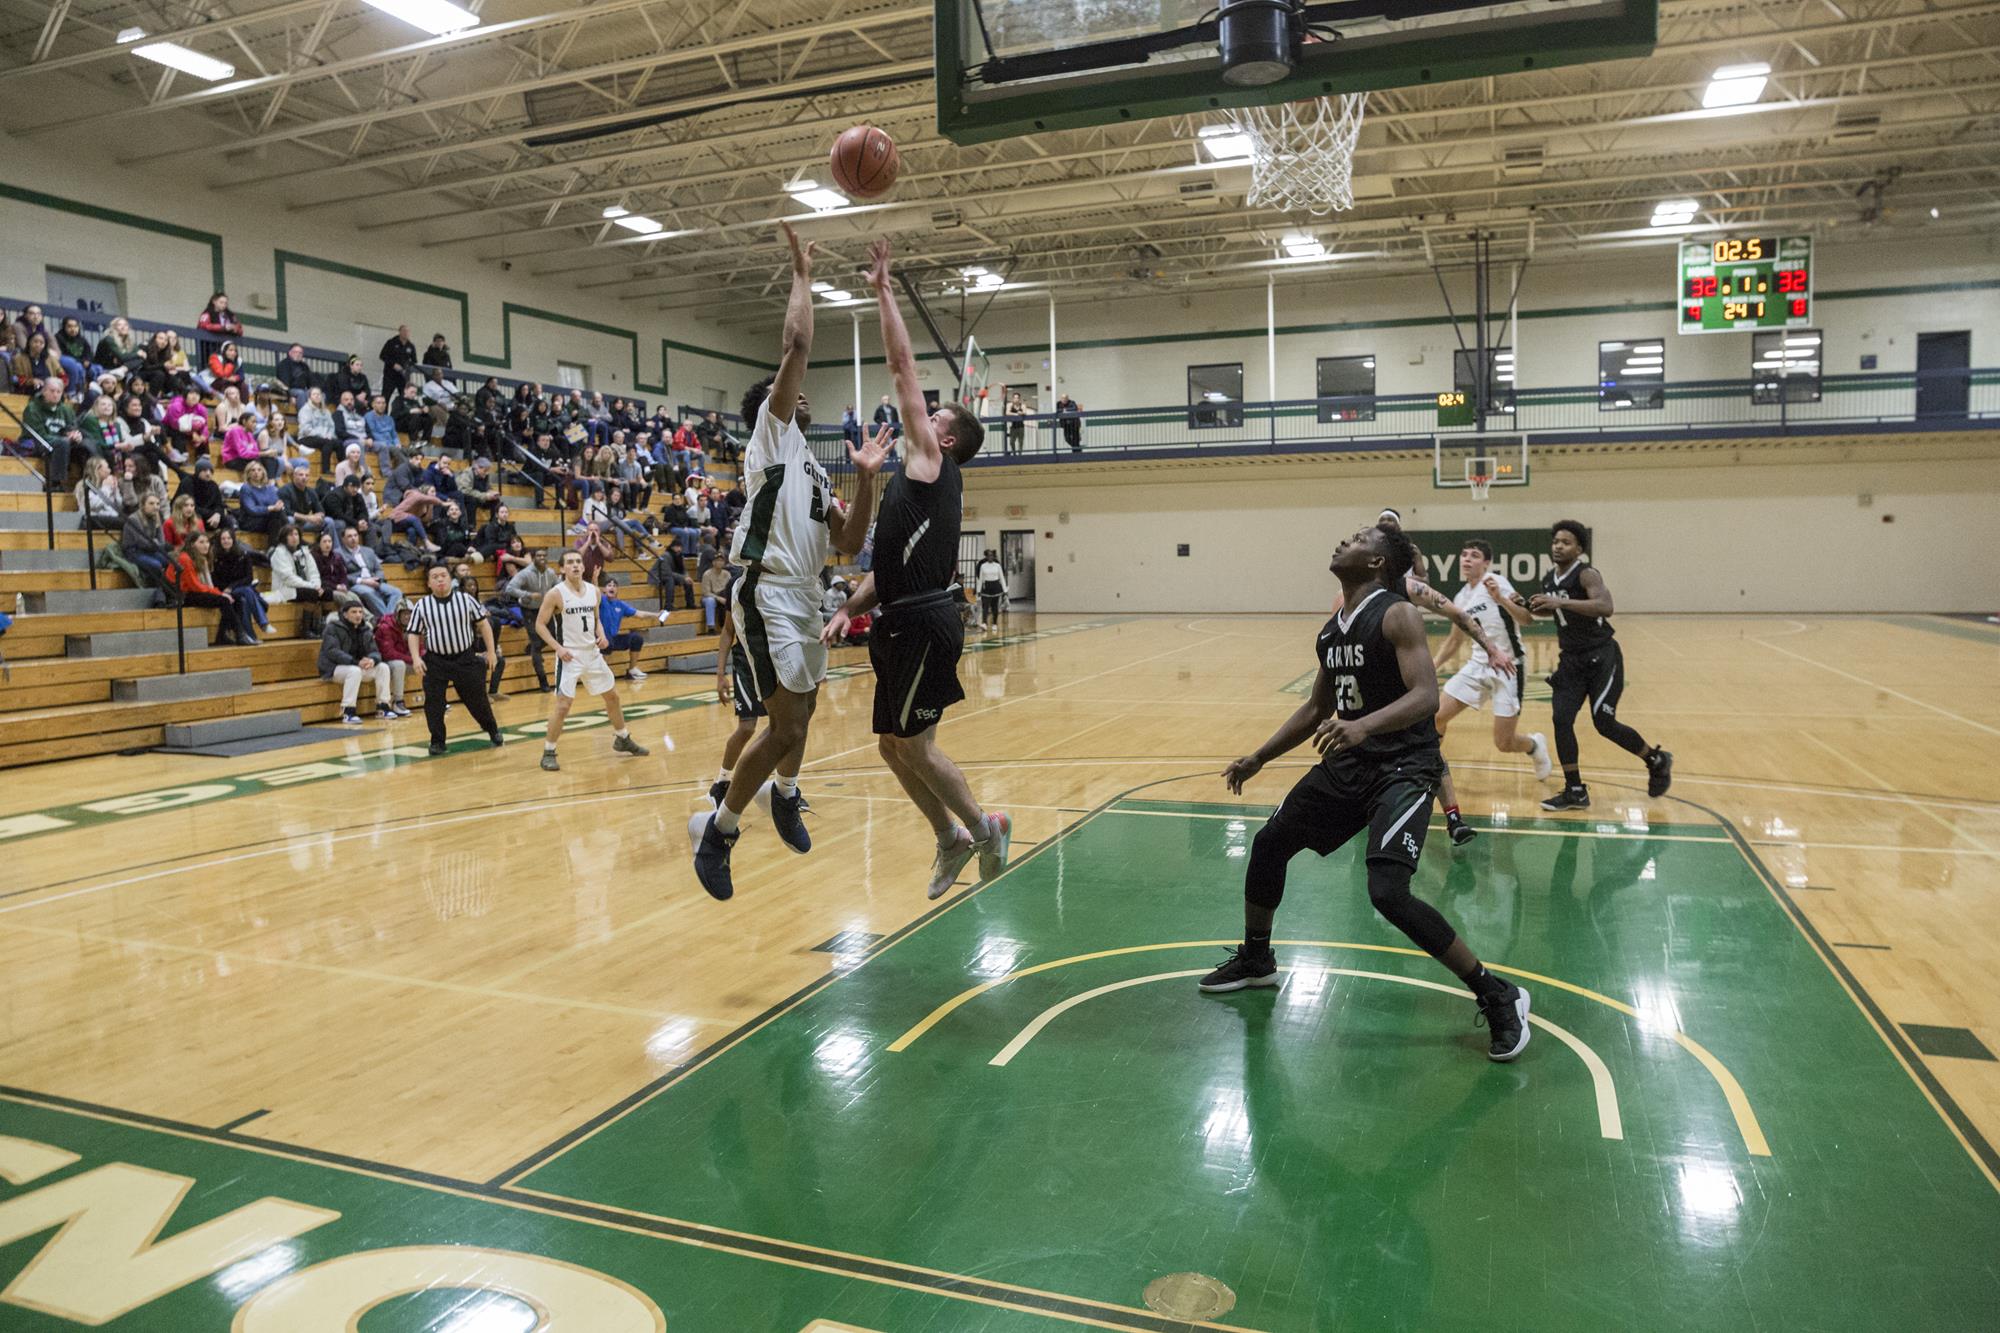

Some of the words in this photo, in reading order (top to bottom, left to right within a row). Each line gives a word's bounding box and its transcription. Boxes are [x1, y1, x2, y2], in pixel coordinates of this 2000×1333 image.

[1714, 238, 1762, 263] 02.5
[1691, 276, 1717, 298] 32
[1779, 269, 1807, 293] 32
[1438, 393, 1465, 407] 02.4
[581, 615, 589, 632] 1
[1326, 644, 1365, 669] RAMS
[1335, 674, 1364, 711] 23
[915, 708, 938, 720] FSC
[1402, 831, 1419, 859] FSC
